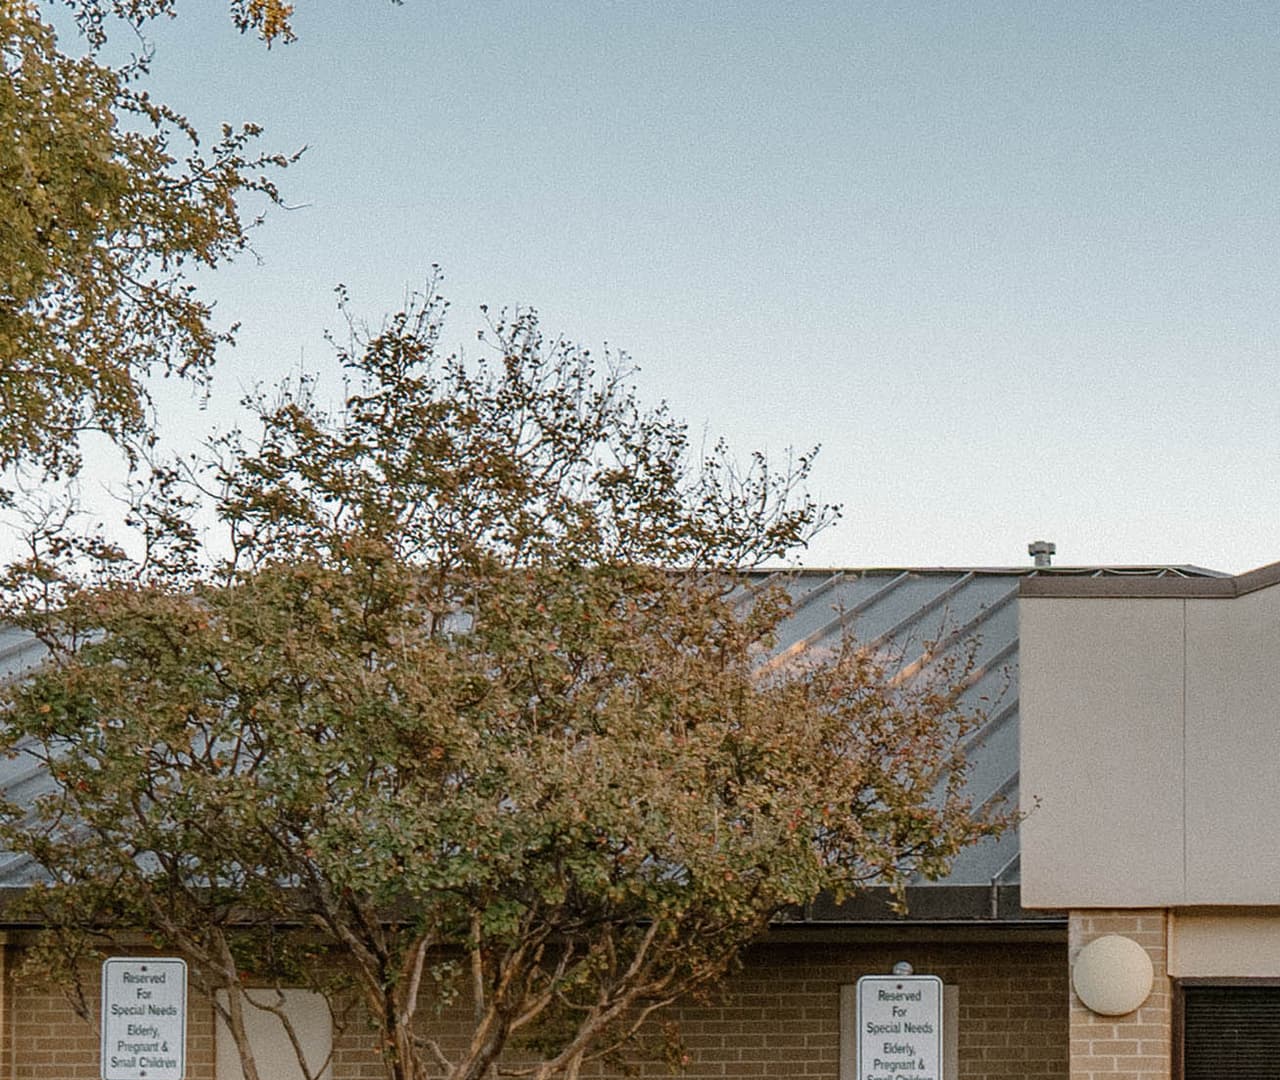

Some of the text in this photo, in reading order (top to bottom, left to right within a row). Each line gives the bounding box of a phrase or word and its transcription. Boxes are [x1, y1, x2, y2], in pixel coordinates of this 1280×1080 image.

[123, 972, 166, 984] Reserved
[136, 988, 152, 999] For
[878, 990, 921, 1001] Reserved
[111, 1004, 177, 1017] Special Needs
[892, 1006, 907, 1017] For
[867, 1022, 933, 1035] Special Needs
[117, 1041, 159, 1054] Pregnant
[111, 1056, 177, 1068] Small Children
[874, 1059, 915, 1072] Pregnant
